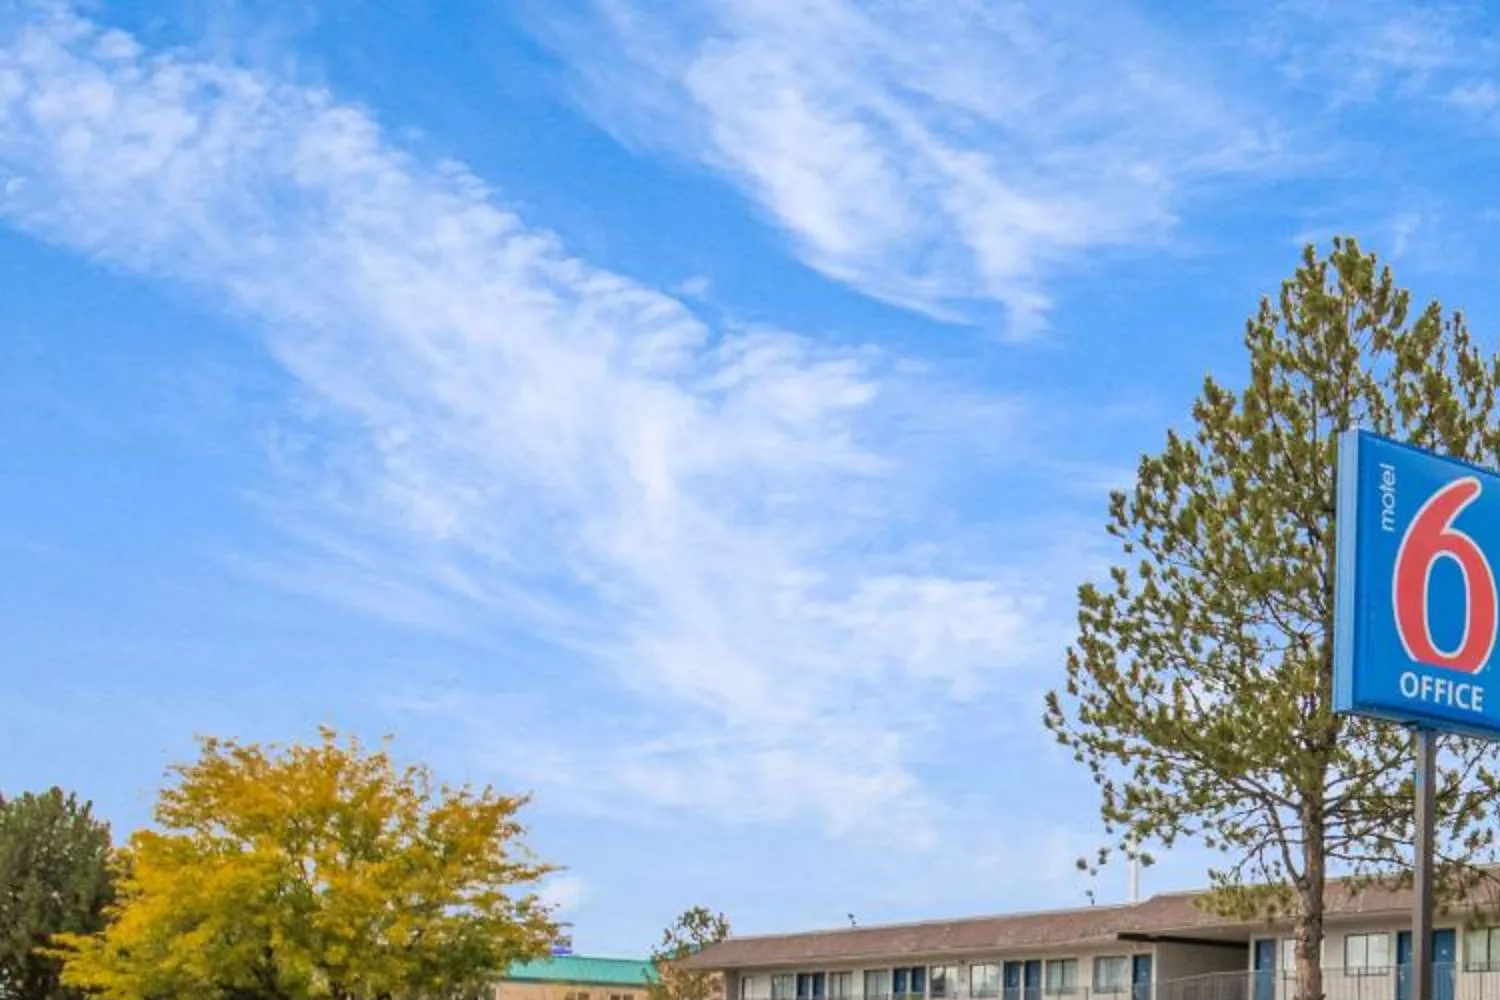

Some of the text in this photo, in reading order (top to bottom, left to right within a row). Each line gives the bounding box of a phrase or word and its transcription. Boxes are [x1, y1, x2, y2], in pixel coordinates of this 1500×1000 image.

[1380, 463, 1396, 532] motel
[1392, 476, 1498, 674] 6
[1399, 671, 1484, 712] OFFICE
